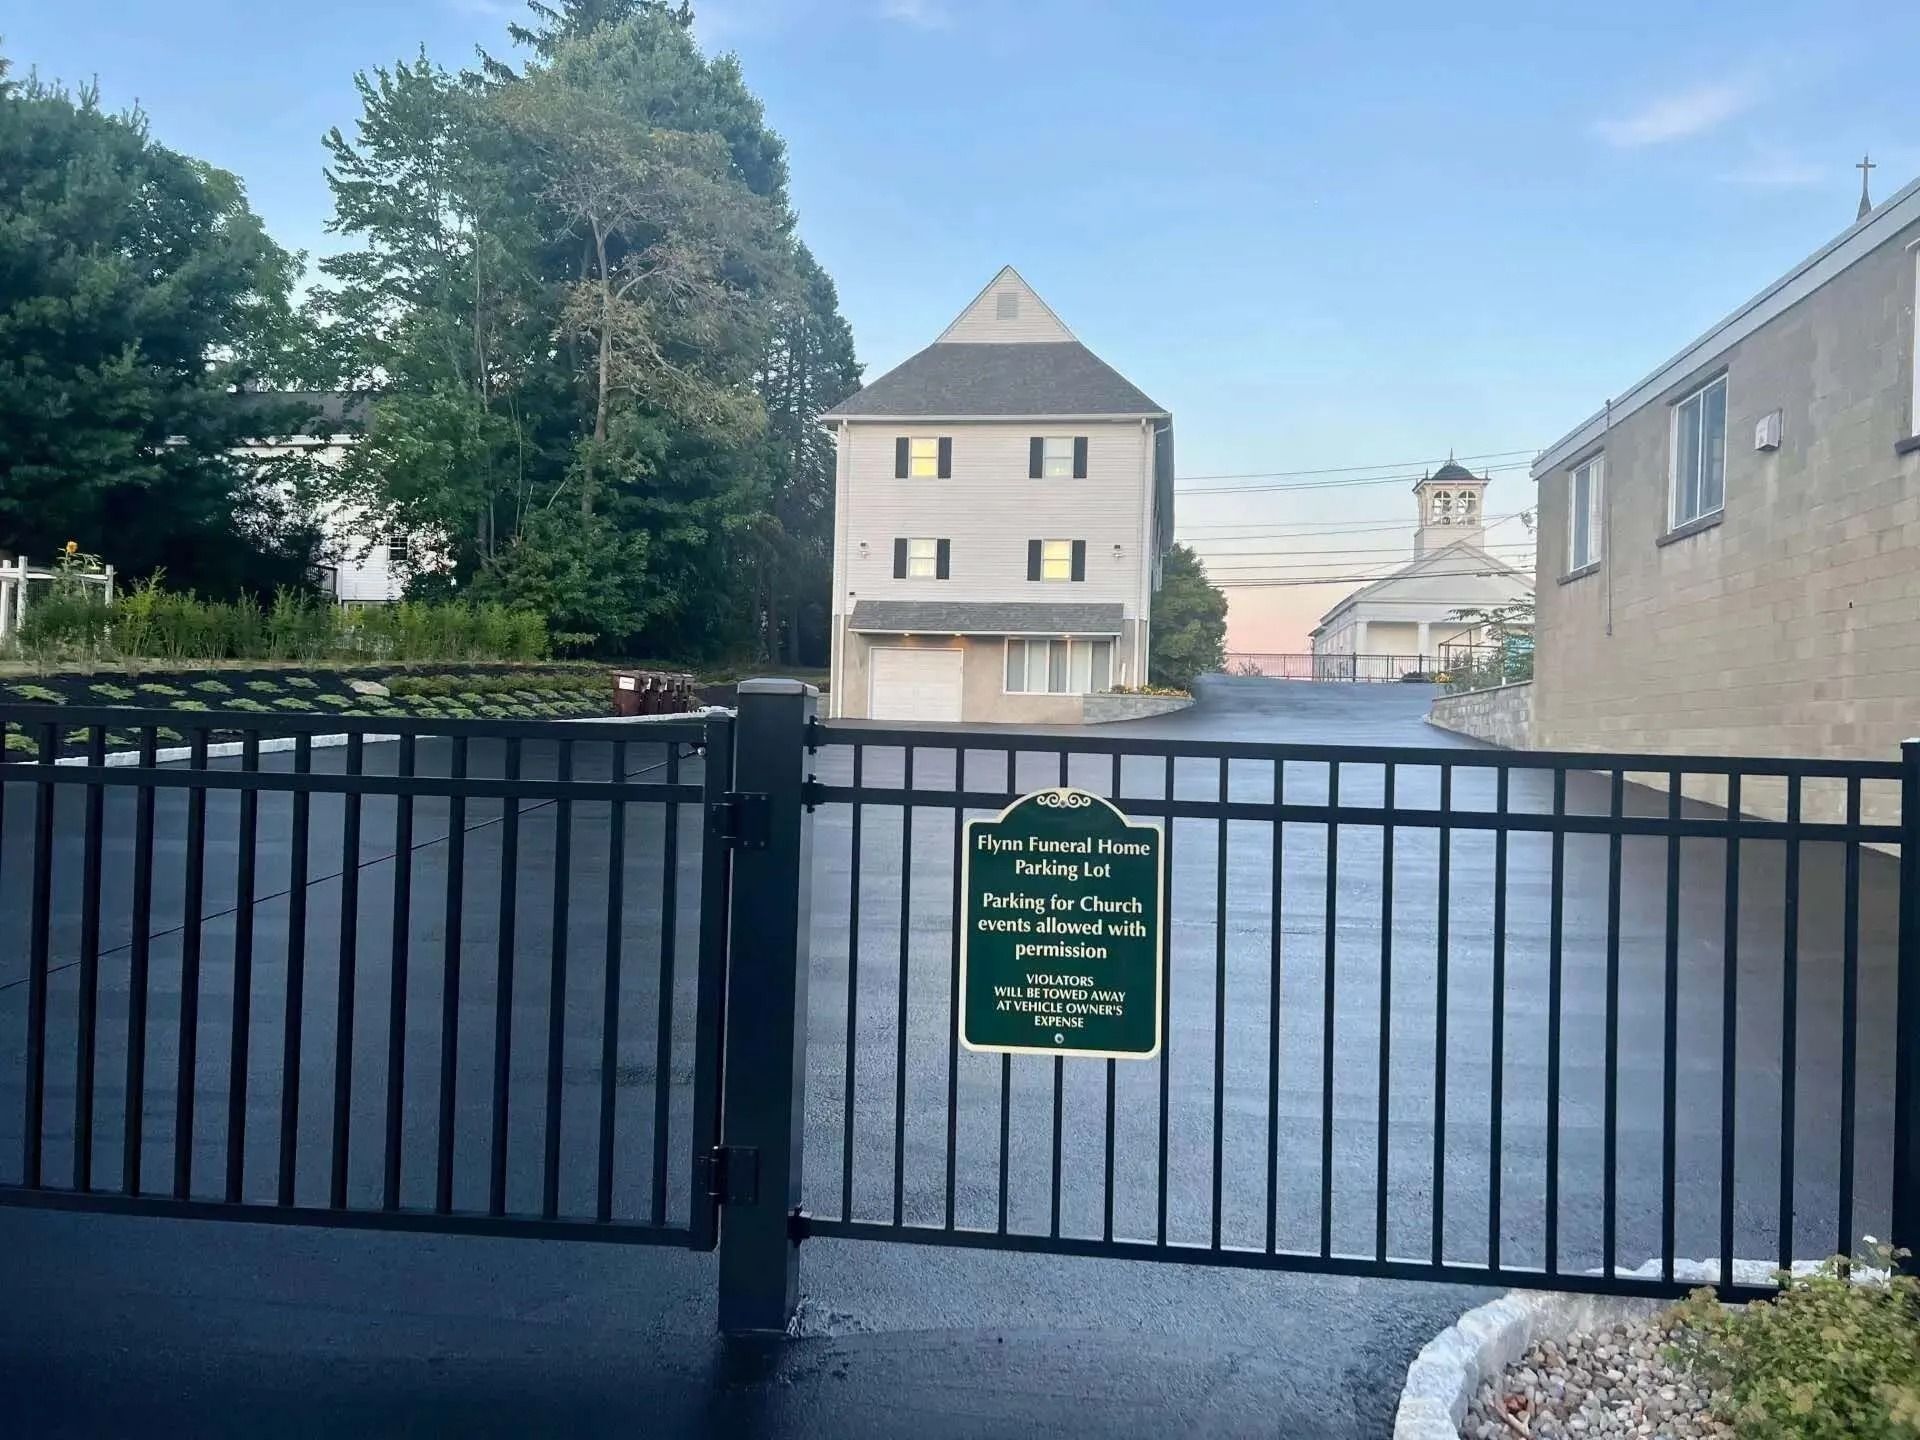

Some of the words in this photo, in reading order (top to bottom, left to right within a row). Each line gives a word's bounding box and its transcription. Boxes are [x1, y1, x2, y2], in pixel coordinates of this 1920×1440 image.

[977, 834, 1023, 855] Flynn
[1029, 836, 1092, 854] Funeral
[1098, 838, 1151, 856] Home
[1015, 859, 1078, 881] Parking
[1083, 861, 1111, 878] Lot
[983, 892, 1046, 915] Parking
[1050, 893, 1074, 911] for
[1080, 895, 1143, 914] Church
[978, 917, 1031, 932] events
[1036, 917, 1103, 935] allowed
[1108, 920, 1147, 937] with
[1015, 941, 1107, 960] permission
[1026, 973, 1094, 987] VIOLATORS
[994, 986, 1023, 998] WILL
[1026, 987, 1041, 999] BE
[1042, 988, 1088, 1001] TOWED
[1090, 990, 1126, 1003] AWAY
[996, 1000, 1012, 1011] AT
[1013, 1001, 1063, 1014] VEHICLE
[1066, 1003, 1123, 1016] OWNER'S
[1034, 1015, 1084, 1028] EXPENSE
